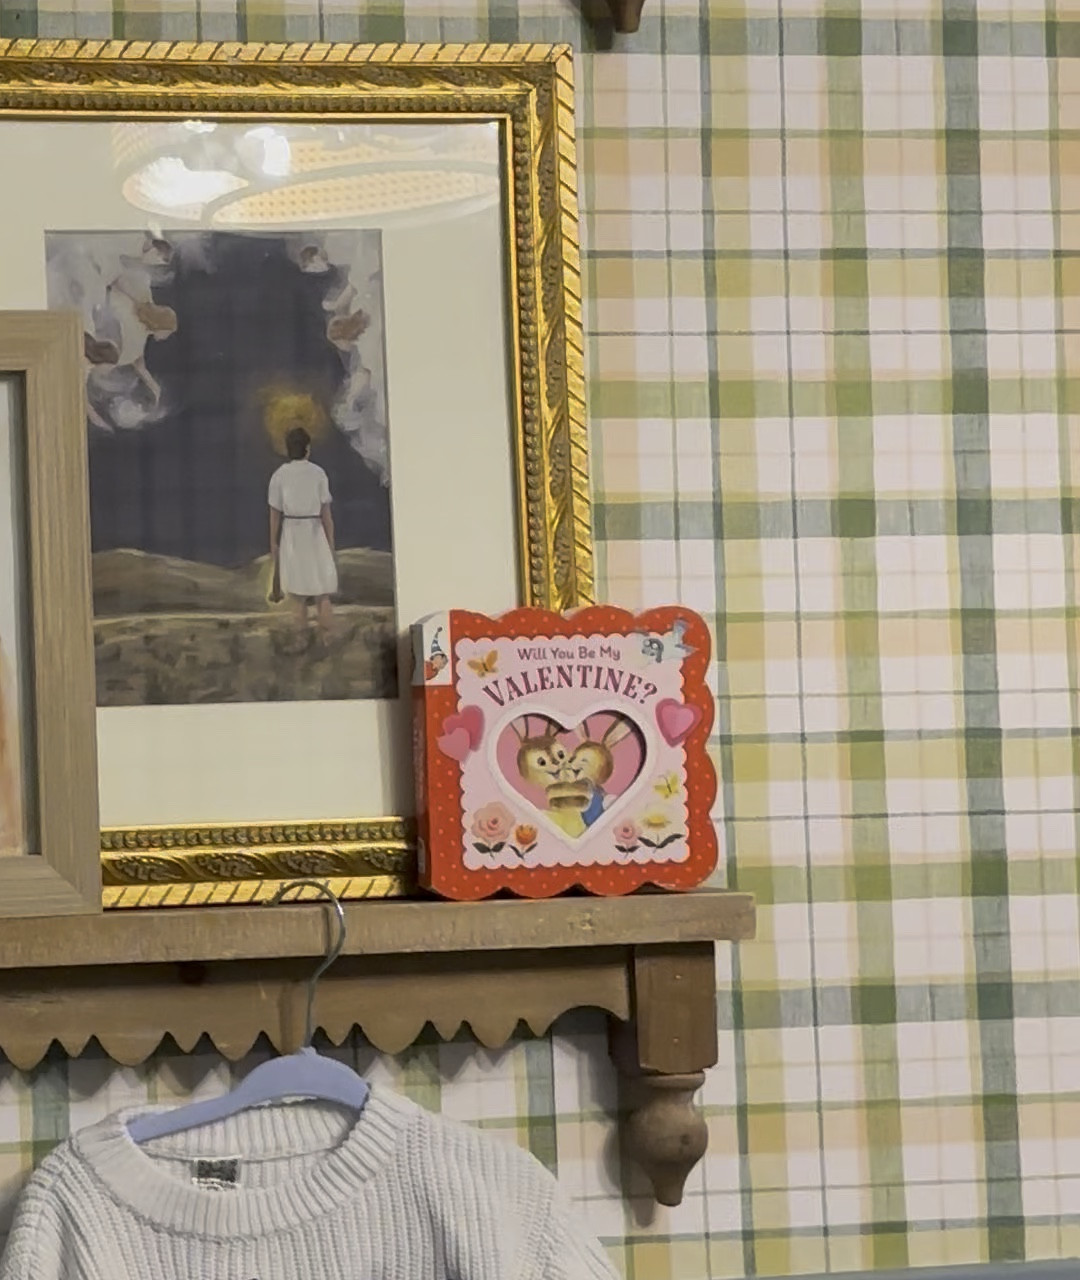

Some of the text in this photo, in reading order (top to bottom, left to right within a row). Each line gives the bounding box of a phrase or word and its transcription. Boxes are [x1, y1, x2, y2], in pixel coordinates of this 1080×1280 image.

[517, 645, 621, 661] Will You Be My
[482, 664, 658, 707] VALENTINE?
